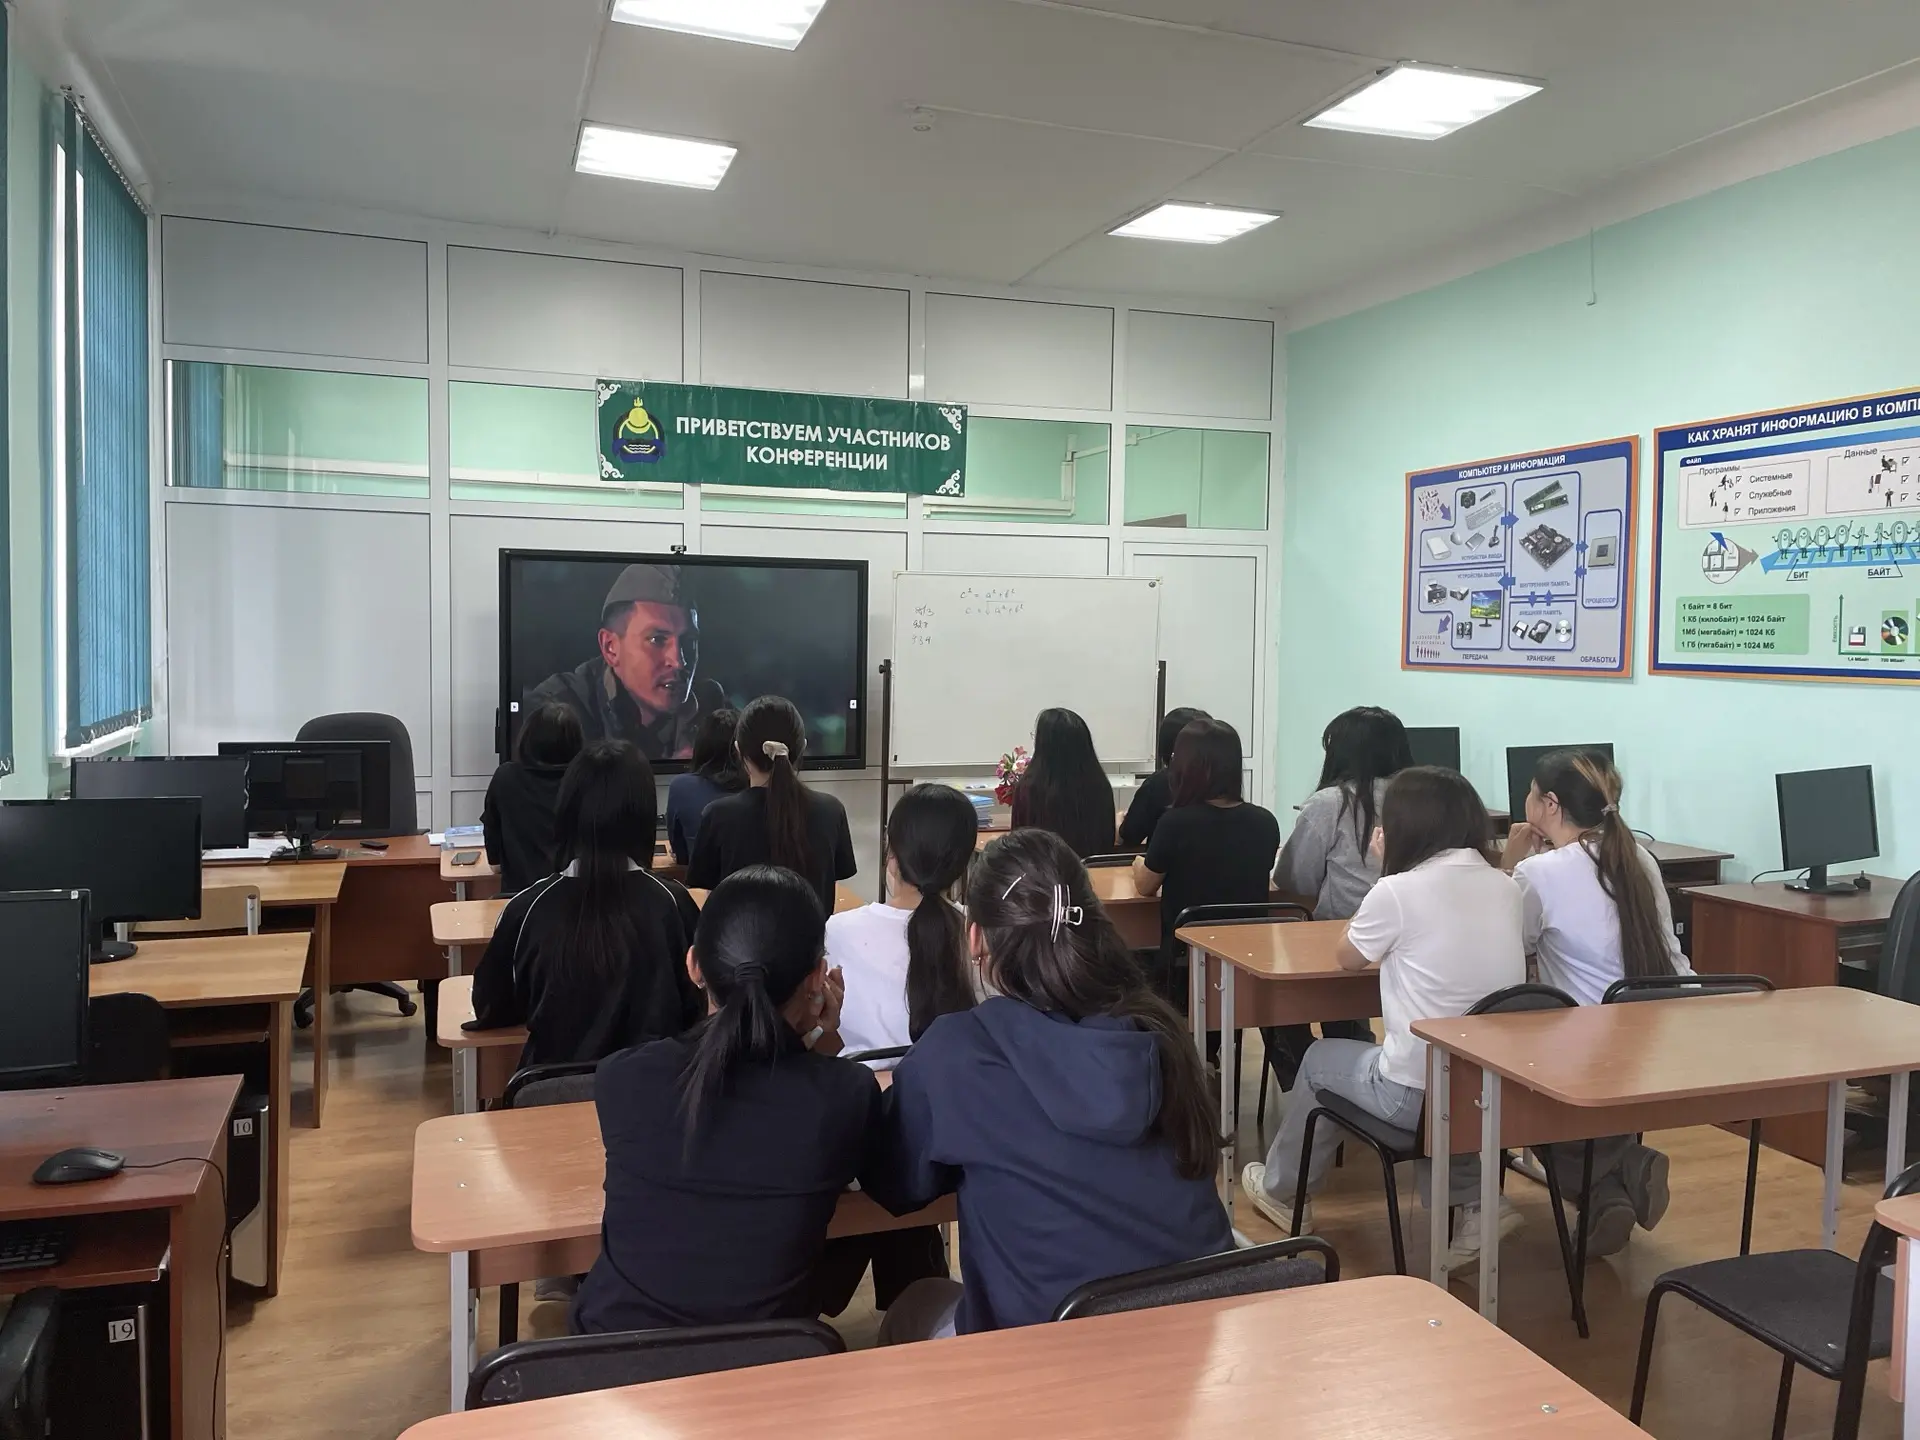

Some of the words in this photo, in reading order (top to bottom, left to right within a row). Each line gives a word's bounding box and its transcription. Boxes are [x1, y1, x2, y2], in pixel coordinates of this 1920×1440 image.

[1687, 429, 1710, 444] КАК
[1712, 422, 1758, 441] ХРАНЯТ
[1761, 407, 1859, 434] ИНФОРМАЦИЮ
[1862, 405, 1872, 418] В
[675, 416, 823, 443] ПРИВЕТСТВУЕМ
[827, 427, 951, 451] УЧАСТНИКОВ
[746, 446, 888, 471] КОНФЕРЕНЦИИ
[1843, 448, 1878, 460] Данные
[1458, 464, 1502, 480] КОМПЬЮТЕР
[1503, 463, 1510, 472] И
[1510, 454, 1566, 471] ИНФОРМАЦИЯ
[1699, 465, 1741, 477] Программы
[1749, 472, 1793, 484] Системные
[1748, 488, 1792, 501] Служебные
[1748, 504, 1796, 517] Приложения
[1793, 571, 1809, 579] БИТ
[1867, 567, 1891, 577] БАЙТ
[1585, 597, 1617, 605] ПРОЦЕССОР
[1688, 602, 1705, 610] байт
[1719, 602, 1733, 610] бит
[1687, 615, 1697, 623] Кб
[1698, 615, 1739, 624] (килобайт)
[1747, 615, 1765, 623] 1024
[1767, 614, 1786, 623] байт
[1697, 628, 1737, 637] (мегабайт)
[1745, 628, 1763, 636] 1024
[1765, 628, 1776, 636] Кб
[1697, 641, 1735, 650] (гигабайт)
[1743, 641, 1761, 649] 1024
[1762, 641, 1775, 650] Мб
[1462, 653, 1489, 661] ПЕРЕДАЧА
[1580, 655, 1617, 664] ОБРАБОТКА
[235, 1120, 251, 1135] 10
[111, 1321, 133, 1341] 19
